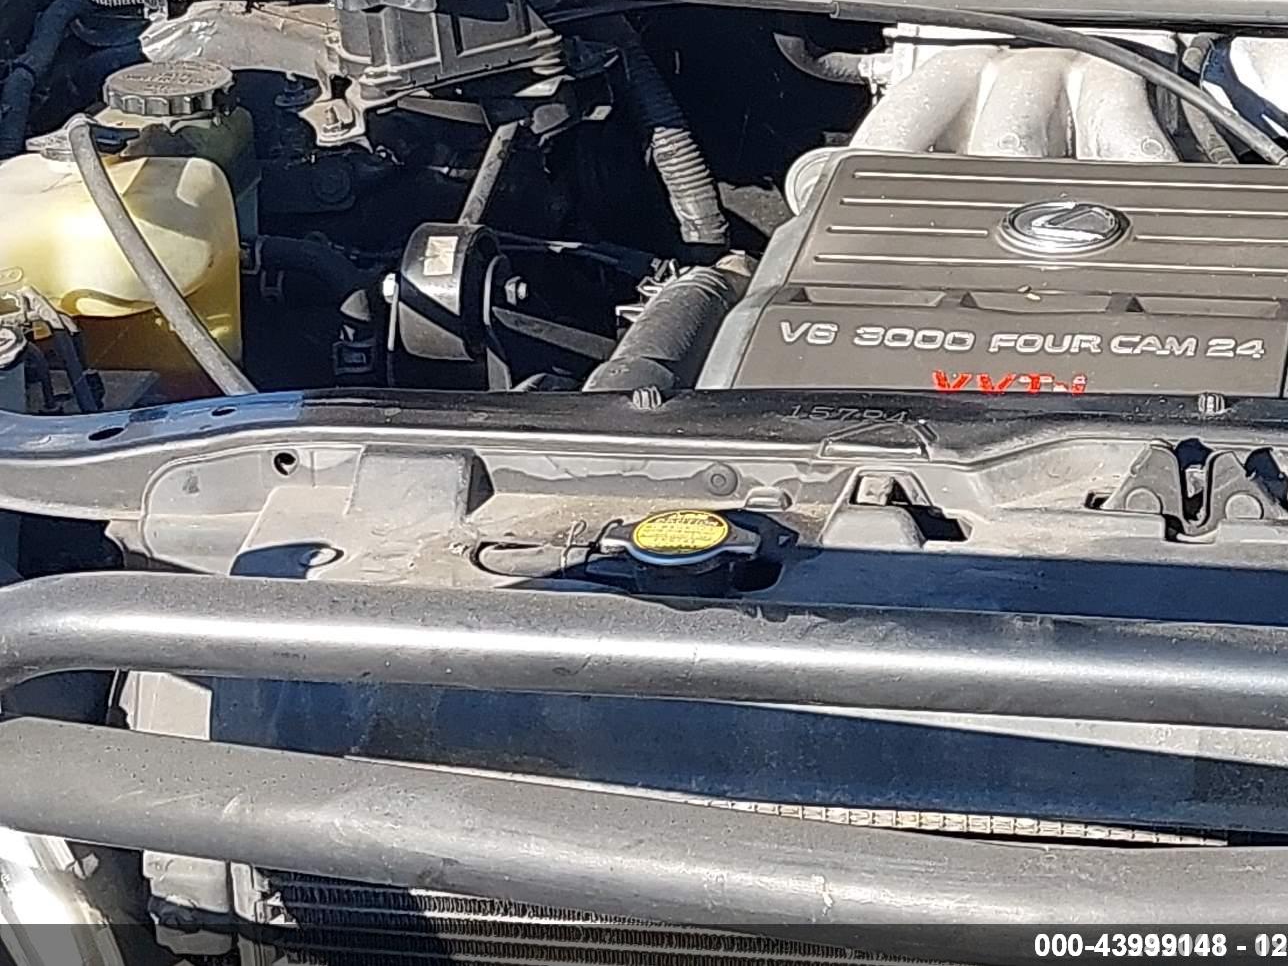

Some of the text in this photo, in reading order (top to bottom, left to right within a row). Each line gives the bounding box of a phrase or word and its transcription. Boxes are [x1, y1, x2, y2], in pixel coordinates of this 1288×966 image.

[780, 321, 1266, 359] V6 3000 FOUR CAM 24
